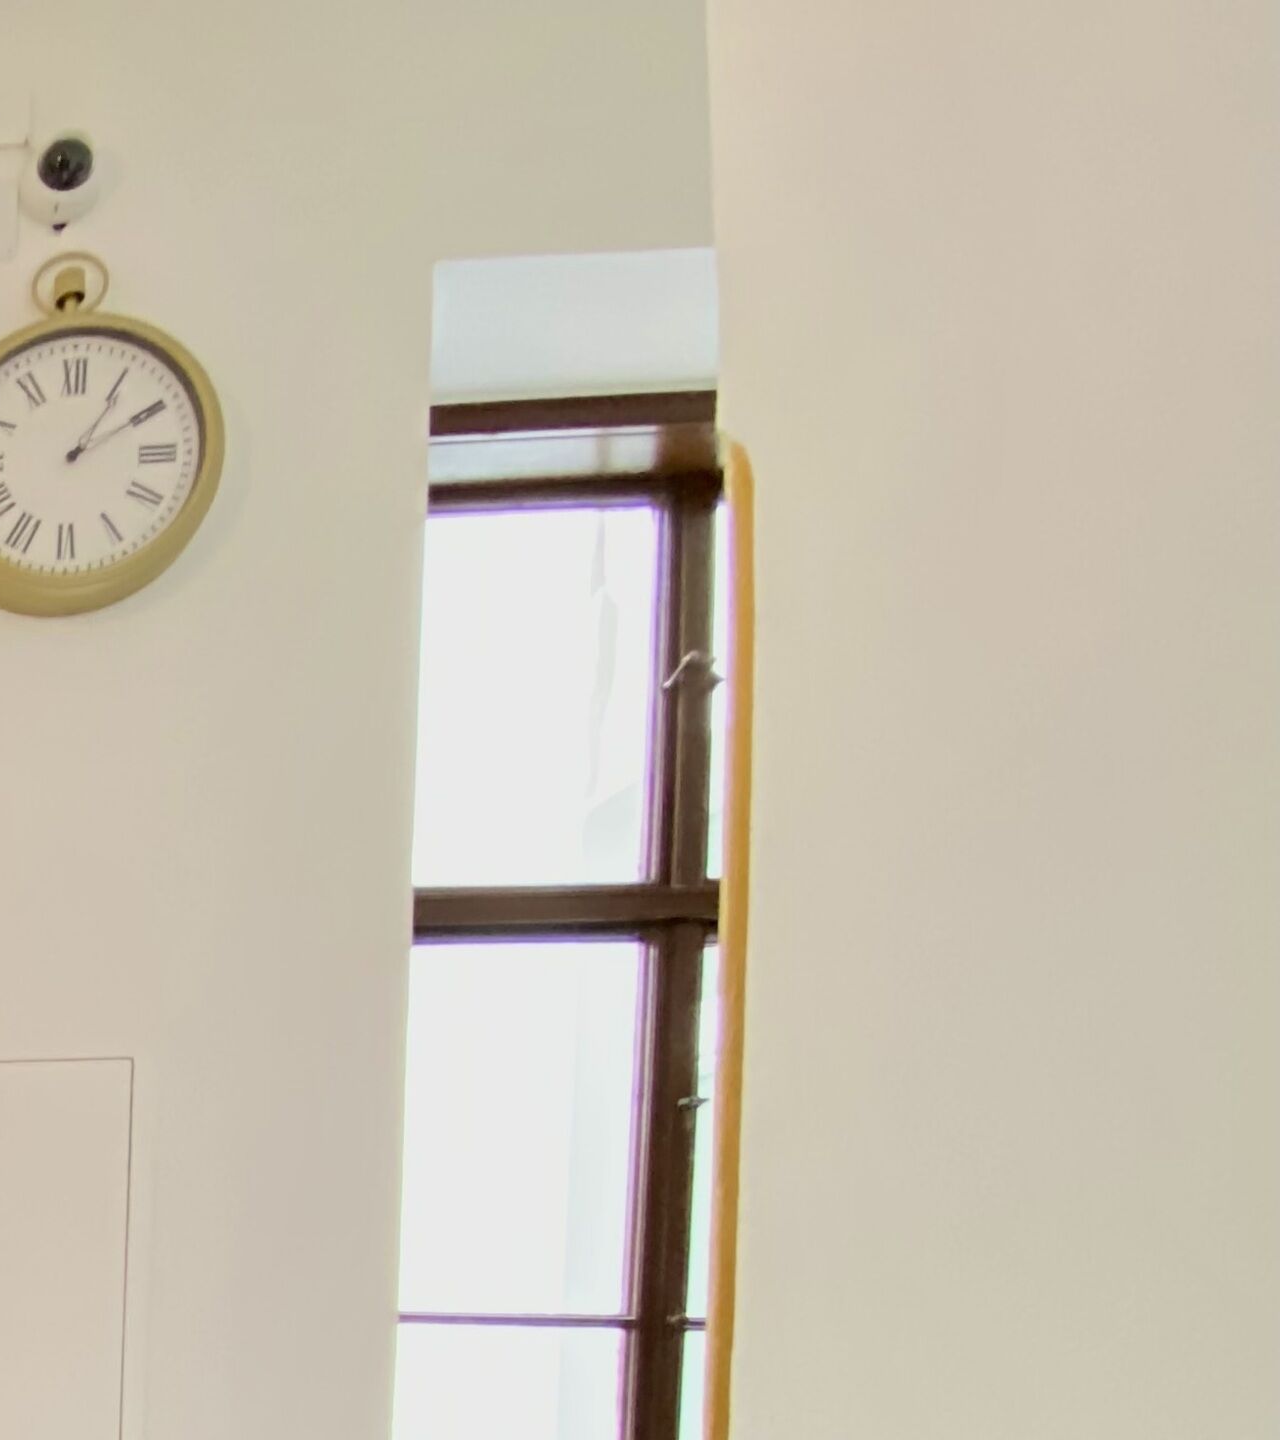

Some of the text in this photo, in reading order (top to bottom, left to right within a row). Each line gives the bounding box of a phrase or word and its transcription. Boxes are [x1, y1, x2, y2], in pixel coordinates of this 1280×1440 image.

[61, 358, 88, 395] XII
[138, 443, 177, 465] III
[4, 512, 42, 554] VII
[56, 522, 76, 560] VI
